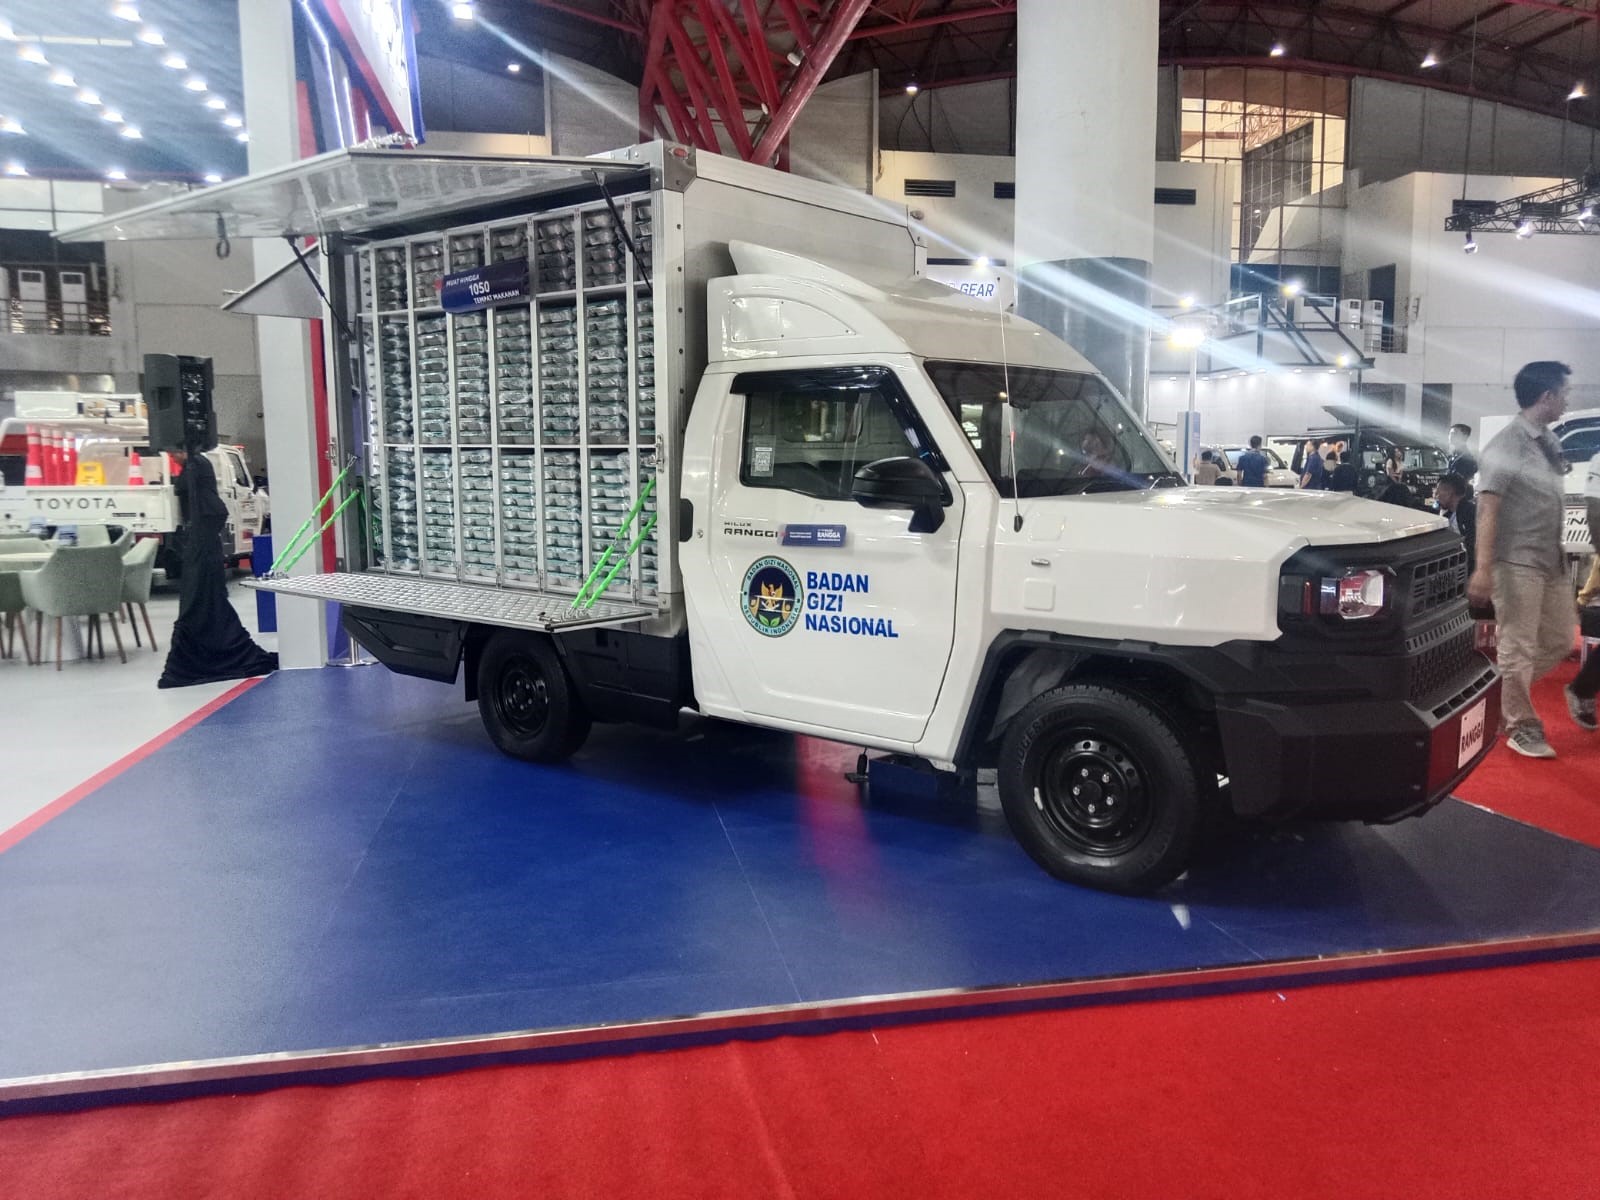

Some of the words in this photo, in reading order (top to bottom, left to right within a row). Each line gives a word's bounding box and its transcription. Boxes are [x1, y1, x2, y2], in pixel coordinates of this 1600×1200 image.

[469, 281, 490, 295] 1050
[960, 283, 995, 297] GEAR
[474, 295, 493, 304] TEMPAT
[493, 289, 520, 300] MAKANAN
[33, 497, 118, 510] TOYOTA
[807, 571, 869, 593] BADAN
[807, 592, 843, 612] GIZI
[805, 613, 899, 638] NASIONAL
